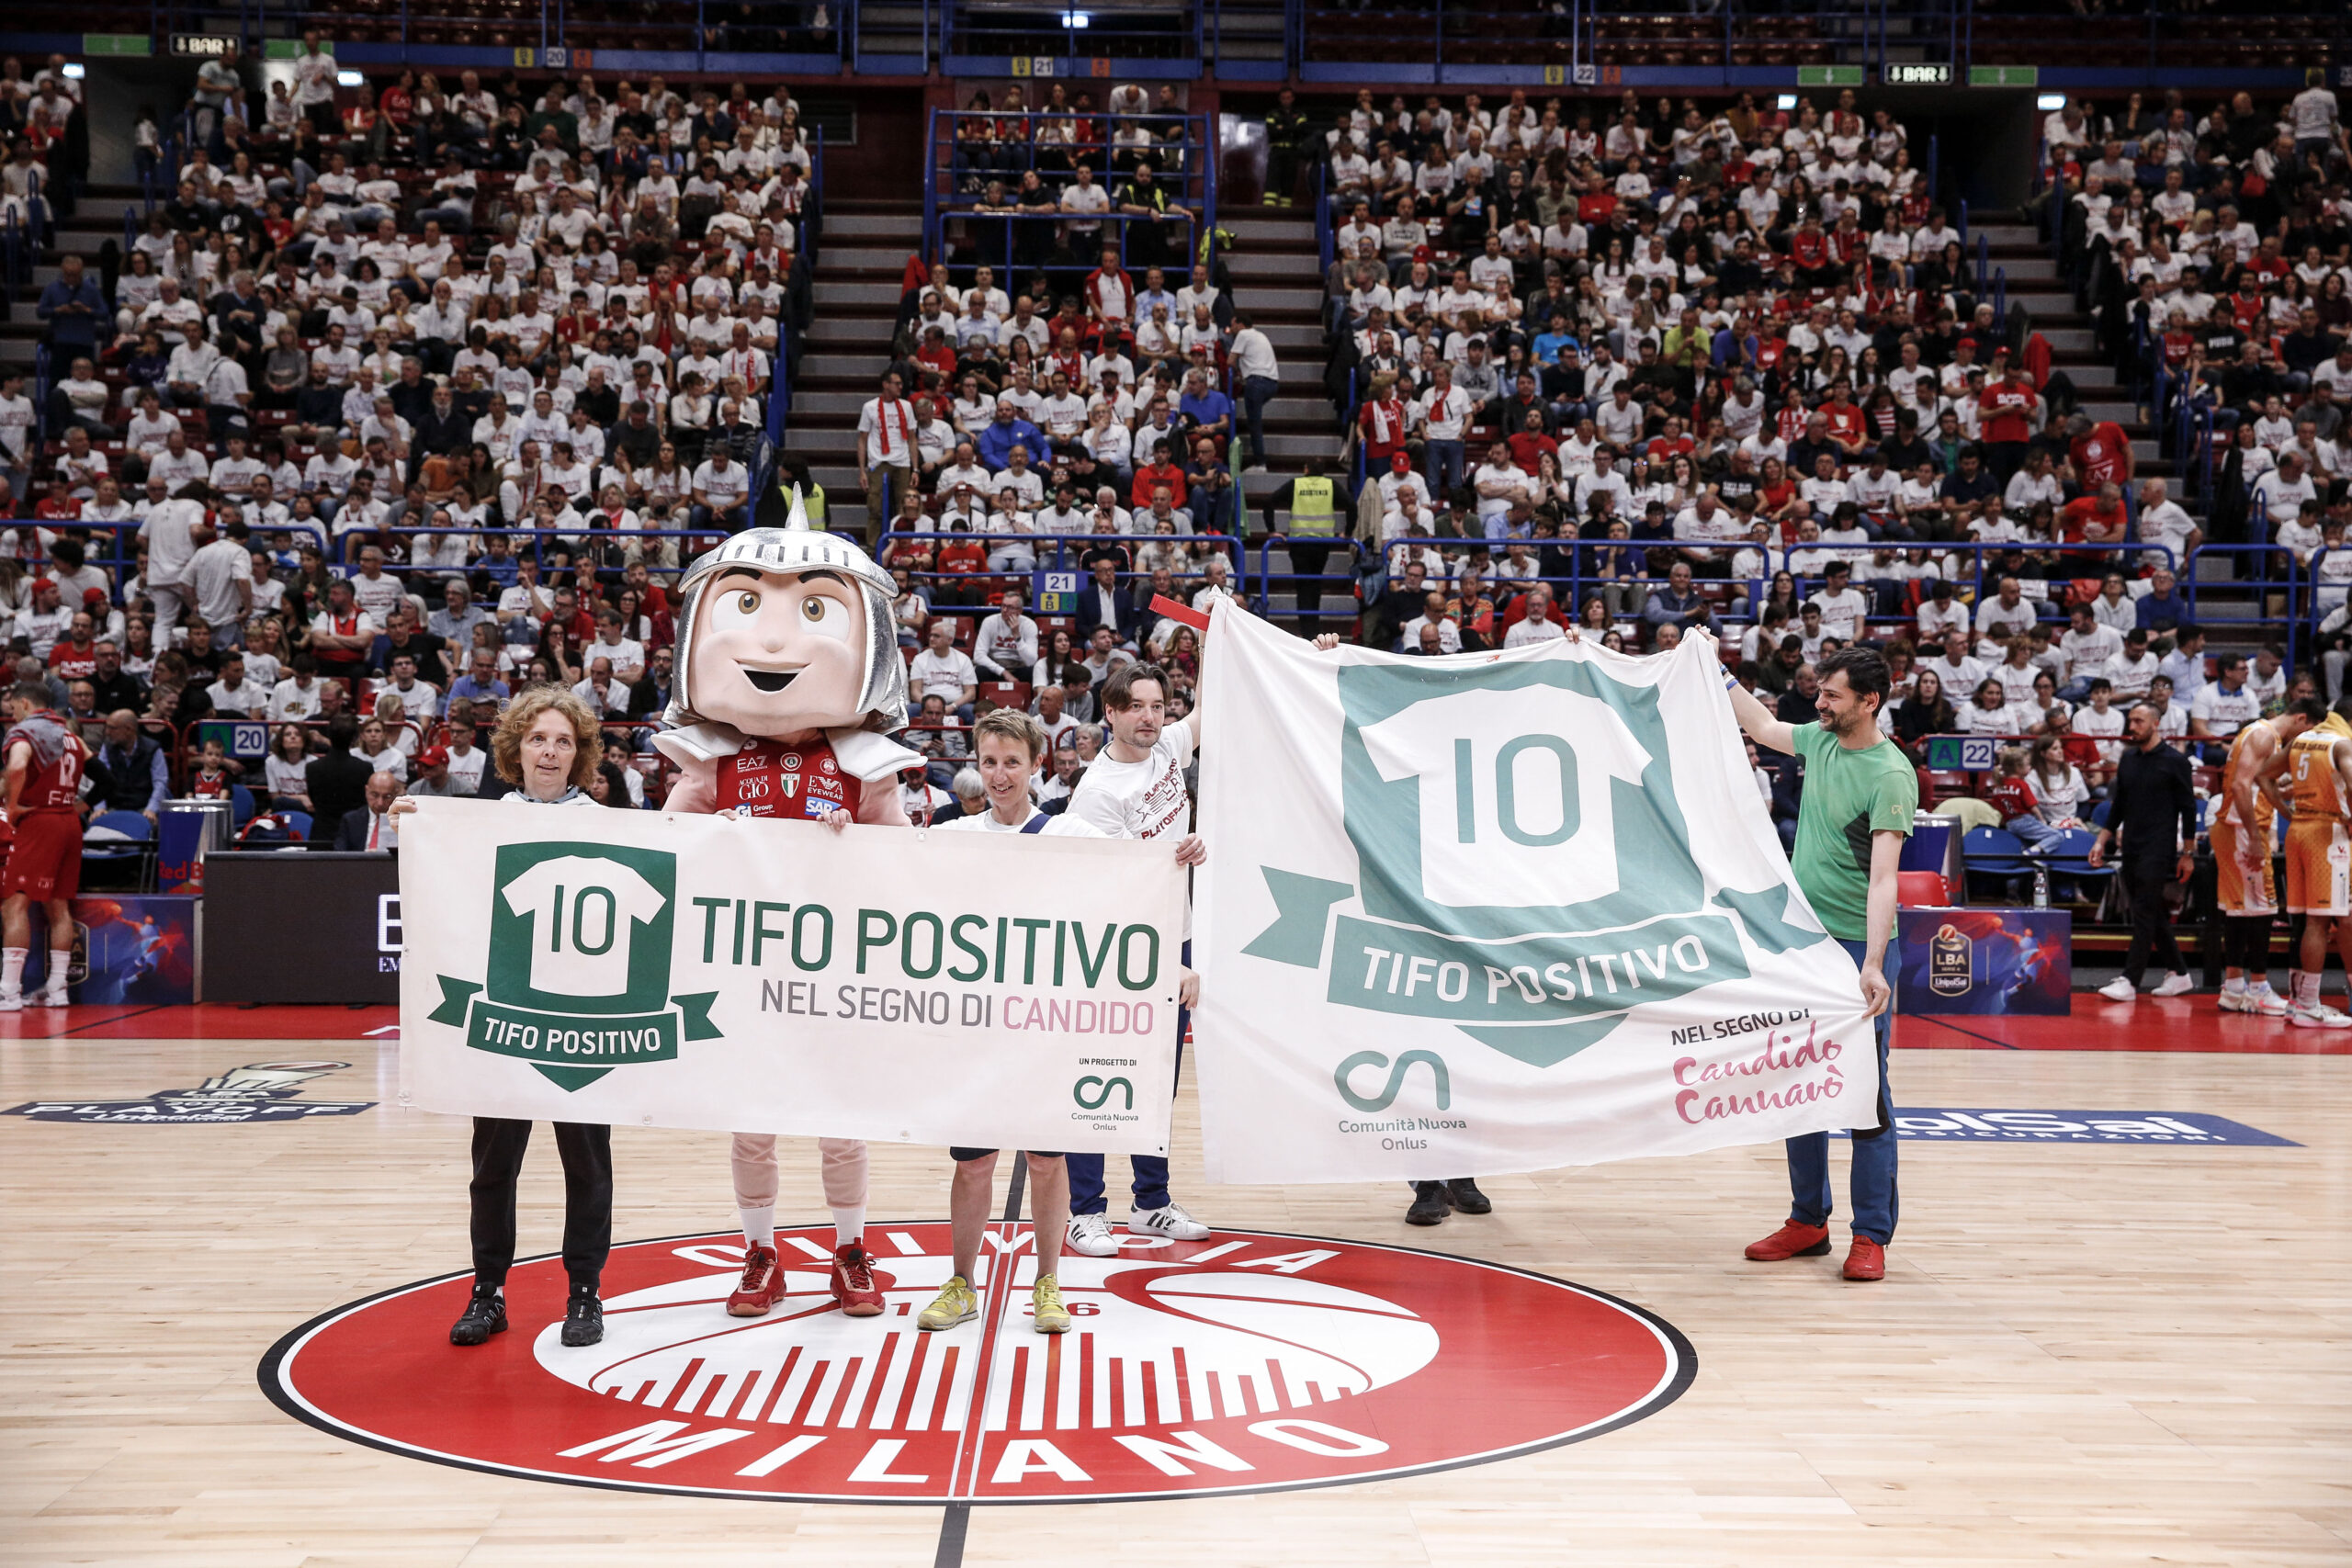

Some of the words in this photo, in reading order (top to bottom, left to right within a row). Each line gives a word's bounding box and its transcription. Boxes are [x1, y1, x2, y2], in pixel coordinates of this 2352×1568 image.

[188, 38, 224, 54] BAR
[548, 51, 564, 62] 20
[1035, 61, 1052, 73] 21
[1577, 68, 1594, 80] 22
[1903, 66, 1938, 82] BAR
[1049, 575, 1069, 589] 21
[1046, 601, 1054, 610] B
[237, 730, 262, 750] 20
[1935, 744, 1955, 762] A
[1965, 745, 1989, 763] 22
[737, 755, 768, 770] EA7
[2296, 752, 2311, 782] 5
[808, 787, 844, 801] EYEWEAR
[1453, 733, 1581, 847] 10
[753, 804, 774, 812] Group
[806, 799, 833, 813] SAP
[551, 885, 616, 956] 10
[693, 897, 834, 972] TIFO
[855, 908, 1160, 991] POSITIVO
[1936, 953, 1966, 965] LBA
[1363, 946, 1470, 1002] TIFO
[1483, 934, 1711, 1004] POSITIVO
[1935, 977, 1967, 987] UnipolSai
[761, 979, 829, 1018] NEL
[836, 985, 950, 1026] SEGNO
[961, 993, 992, 1028] DI
[1002, 996, 1154, 1036] CANDIDO
[1671, 1024, 1713, 1045] NEL
[1713, 1011, 1783, 1039] SEGNO
[1789, 1008, 1810, 1021] DI
[484, 1017, 539, 1050] TIFO
[546, 1027, 662, 1055] POSITIVO
[1672, 1020, 1842, 1086] Candido
[1079, 1057, 1090, 1066] UN
[1091, 1058, 1128, 1066] PROGETTO
[1675, 1064, 1845, 1124] Cannavò
[23, 1105, 352, 1115] PLAYOFF
[1071, 1112, 1112, 1122] Comunità
[1113, 1113, 1139, 1122] Nuova
[1092, 1122, 1117, 1131] Onlus
[1338, 1116, 1416, 1133] Comunità
[1418, 1117, 1467, 1130] Nuova
[1895, 1129, 2227, 1142] SSICURAZIONI
[1381, 1137, 1428, 1151] Onlus
[556, 1418, 1389, 1483] MILANO
